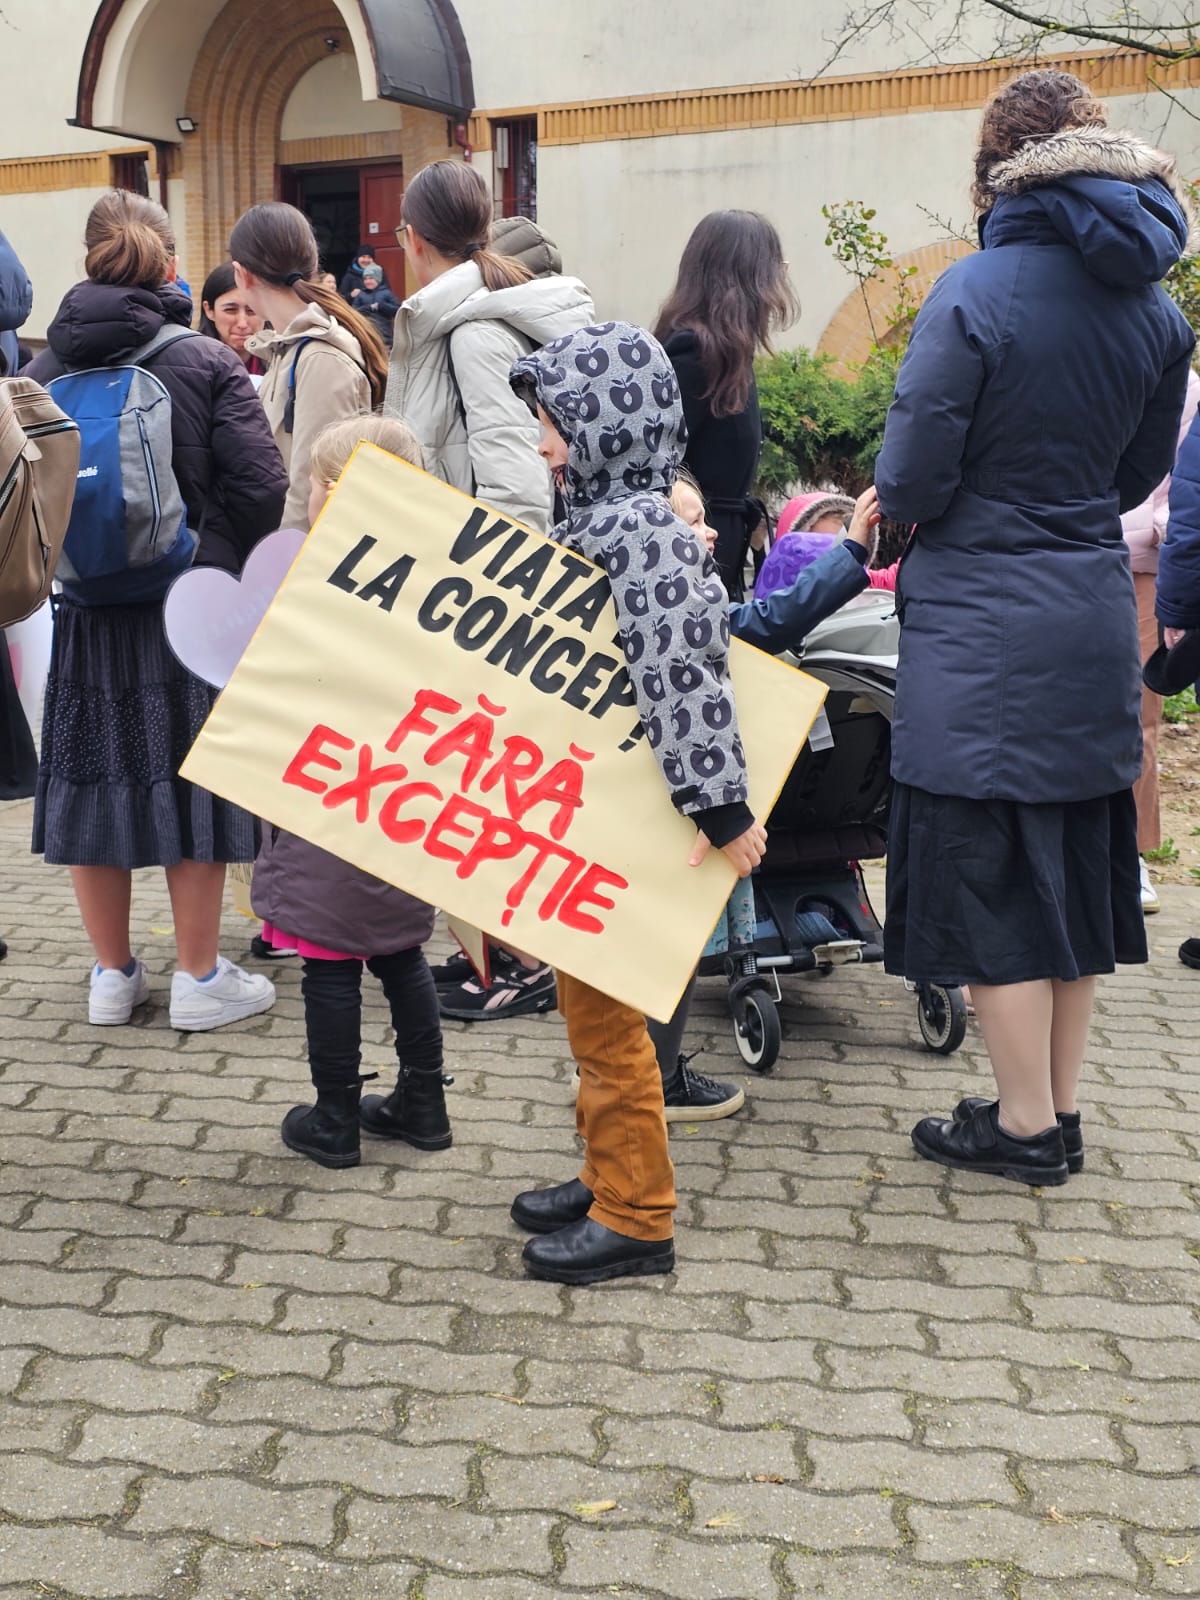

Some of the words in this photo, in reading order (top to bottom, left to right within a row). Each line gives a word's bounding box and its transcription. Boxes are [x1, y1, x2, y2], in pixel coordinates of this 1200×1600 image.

[325, 533, 417, 613] LA
[417, 576, 646, 753] CONCEP
[281, 724, 629, 935] EXCEPȚIE
[384, 689, 595, 841] FĂRĂ
